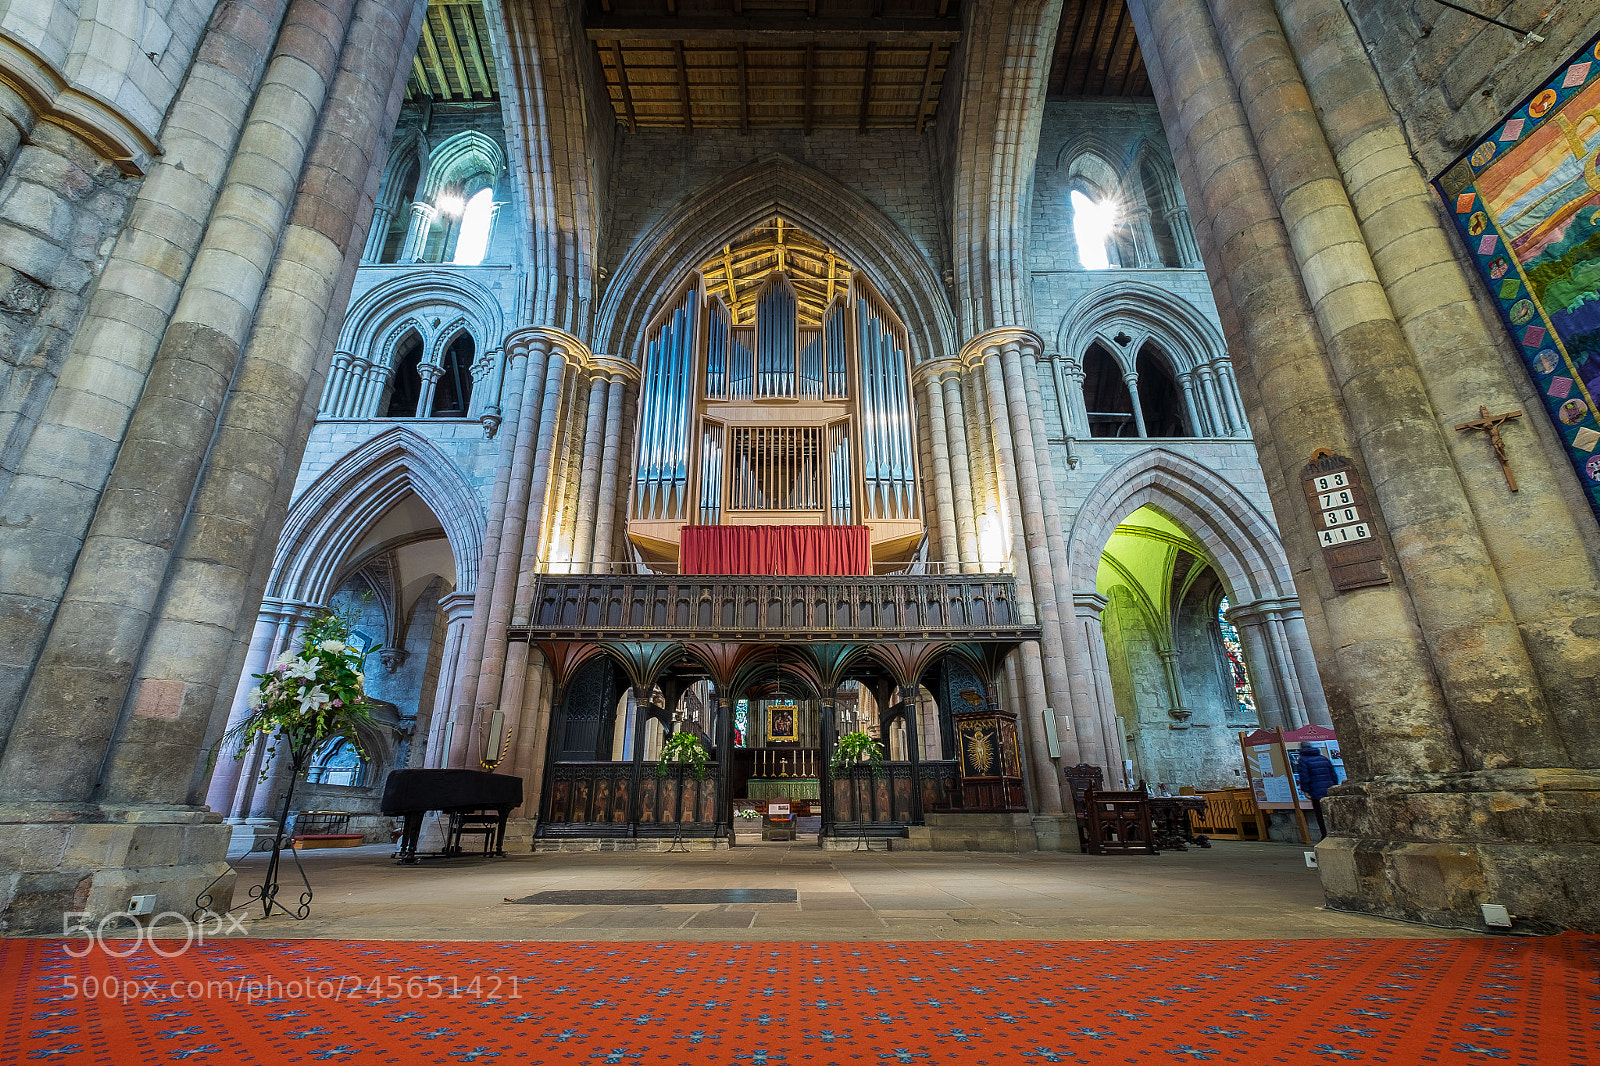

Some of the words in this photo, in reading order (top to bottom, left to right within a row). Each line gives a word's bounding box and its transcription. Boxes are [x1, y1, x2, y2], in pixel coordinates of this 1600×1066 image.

[1319, 474, 1344, 490] 93
[1323, 492, 1349, 506] 79
[1328, 509, 1353, 523] 30
[1324, 526, 1365, 543] 416
